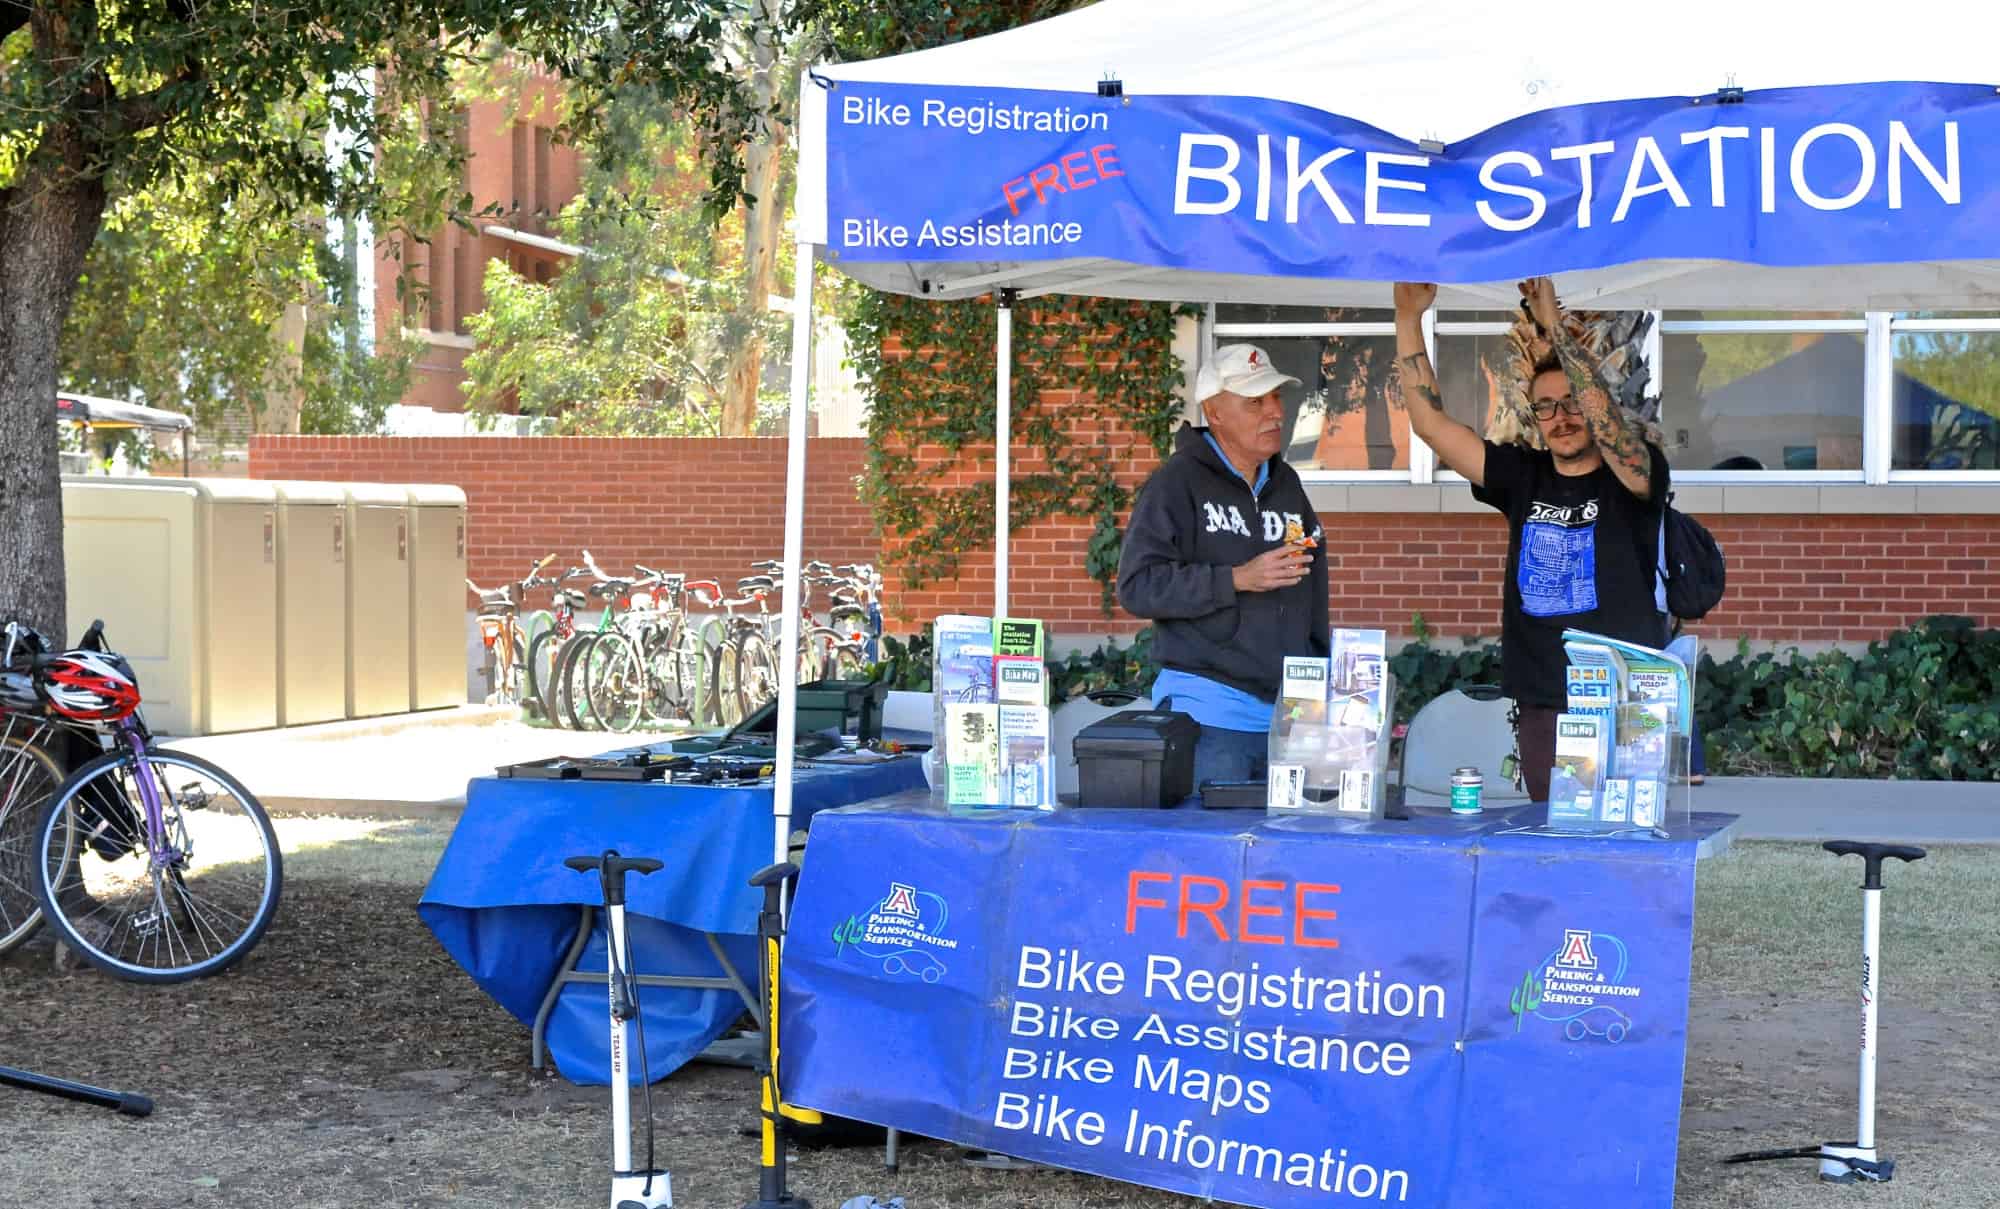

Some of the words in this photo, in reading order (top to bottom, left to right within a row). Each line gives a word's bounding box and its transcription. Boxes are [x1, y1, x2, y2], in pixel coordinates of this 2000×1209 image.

[842, 96, 911, 127] Bike
[922, 100, 1109, 134] Registration
[1003, 144, 1125, 216] FREE
[1173, 132, 1431, 227] BIKE
[1475, 120, 1961, 232] STATION
[842, 219, 909, 248] Bike
[916, 219, 1082, 248] Assistance
[1005, 669, 1021, 681] Bike
[1022, 669, 1036, 682] Map
[1567, 682, 1610, 697] GET
[1562, 723, 1580, 735] Bike
[1580, 724, 1593, 736] Map
[1567, 706, 1611, 715] SMART
[1125, 870, 1341, 948] FREE
[1016, 945, 1125, 995] Bike
[1144, 954, 1446, 1018] Registration
[1009, 1001, 1120, 1040] Bike
[1133, 1013, 1411, 1077] Assistance
[1002, 1047, 1115, 1084] Bike
[1133, 1054, 1272, 1116] Maps
[993, 1092, 1106, 1146] Bike
[1124, 1109, 1409, 1201] Information
